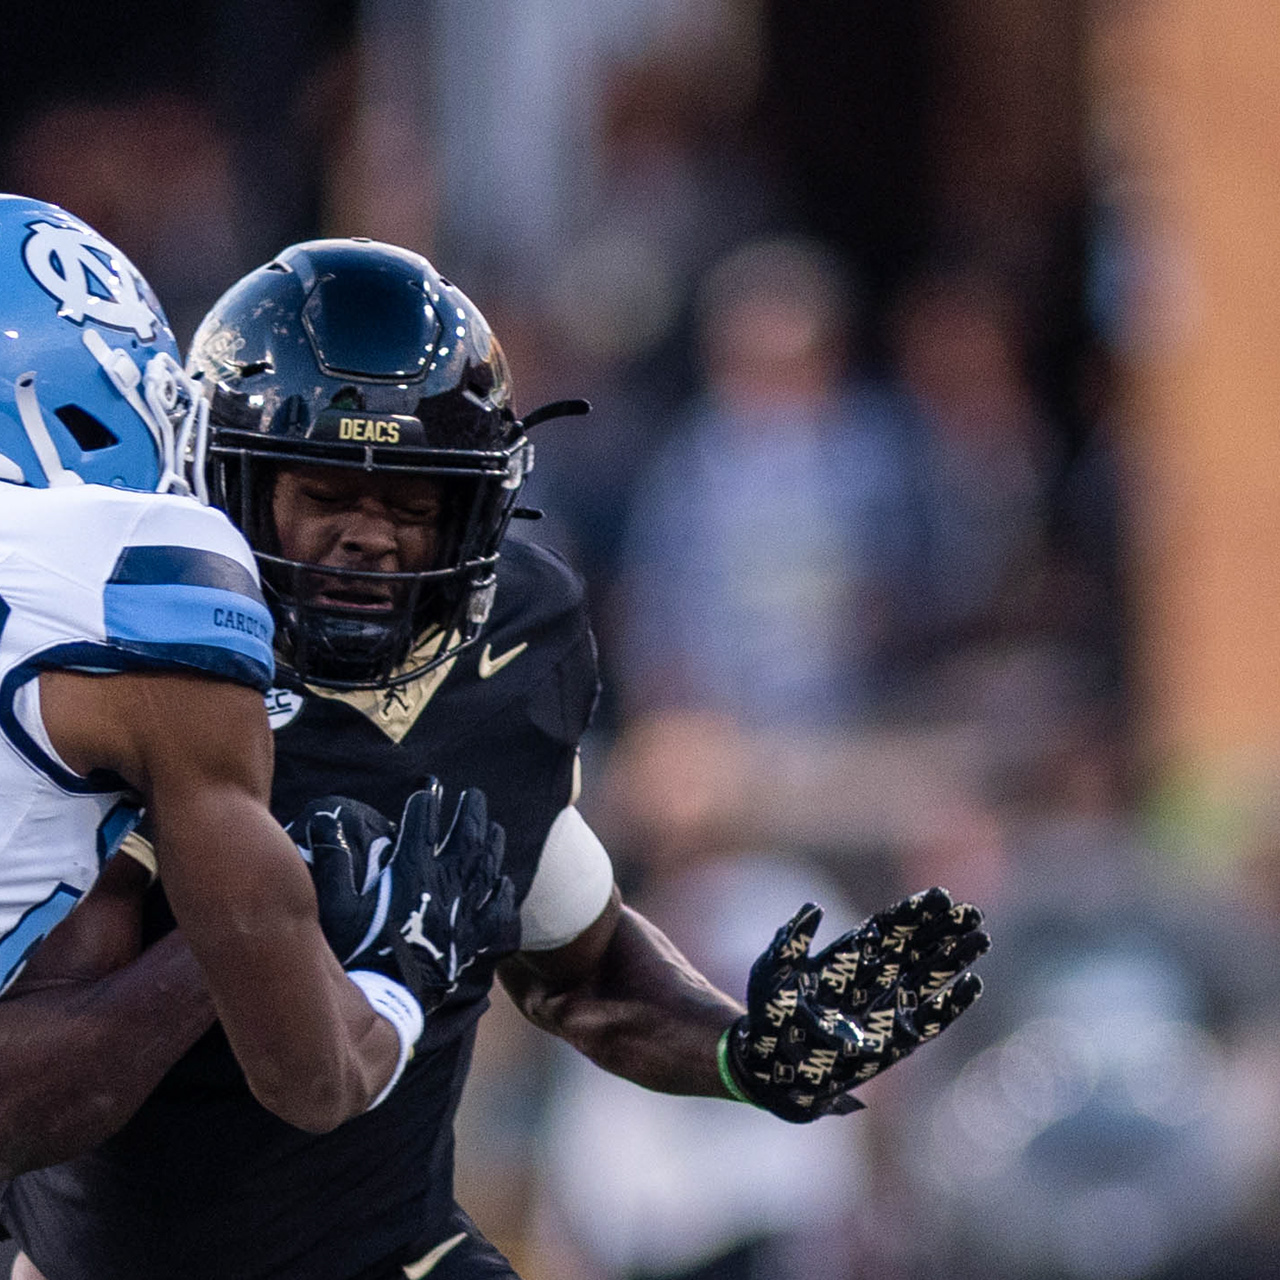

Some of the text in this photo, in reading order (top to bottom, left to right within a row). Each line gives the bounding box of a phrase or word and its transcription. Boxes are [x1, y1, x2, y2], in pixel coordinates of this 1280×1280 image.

[339, 418, 400, 443] DEACS
[821, 951, 860, 994] WF
[765, 989, 798, 1027] WF
[862, 1008, 895, 1053] WF
[797, 1049, 839, 1085] WF
